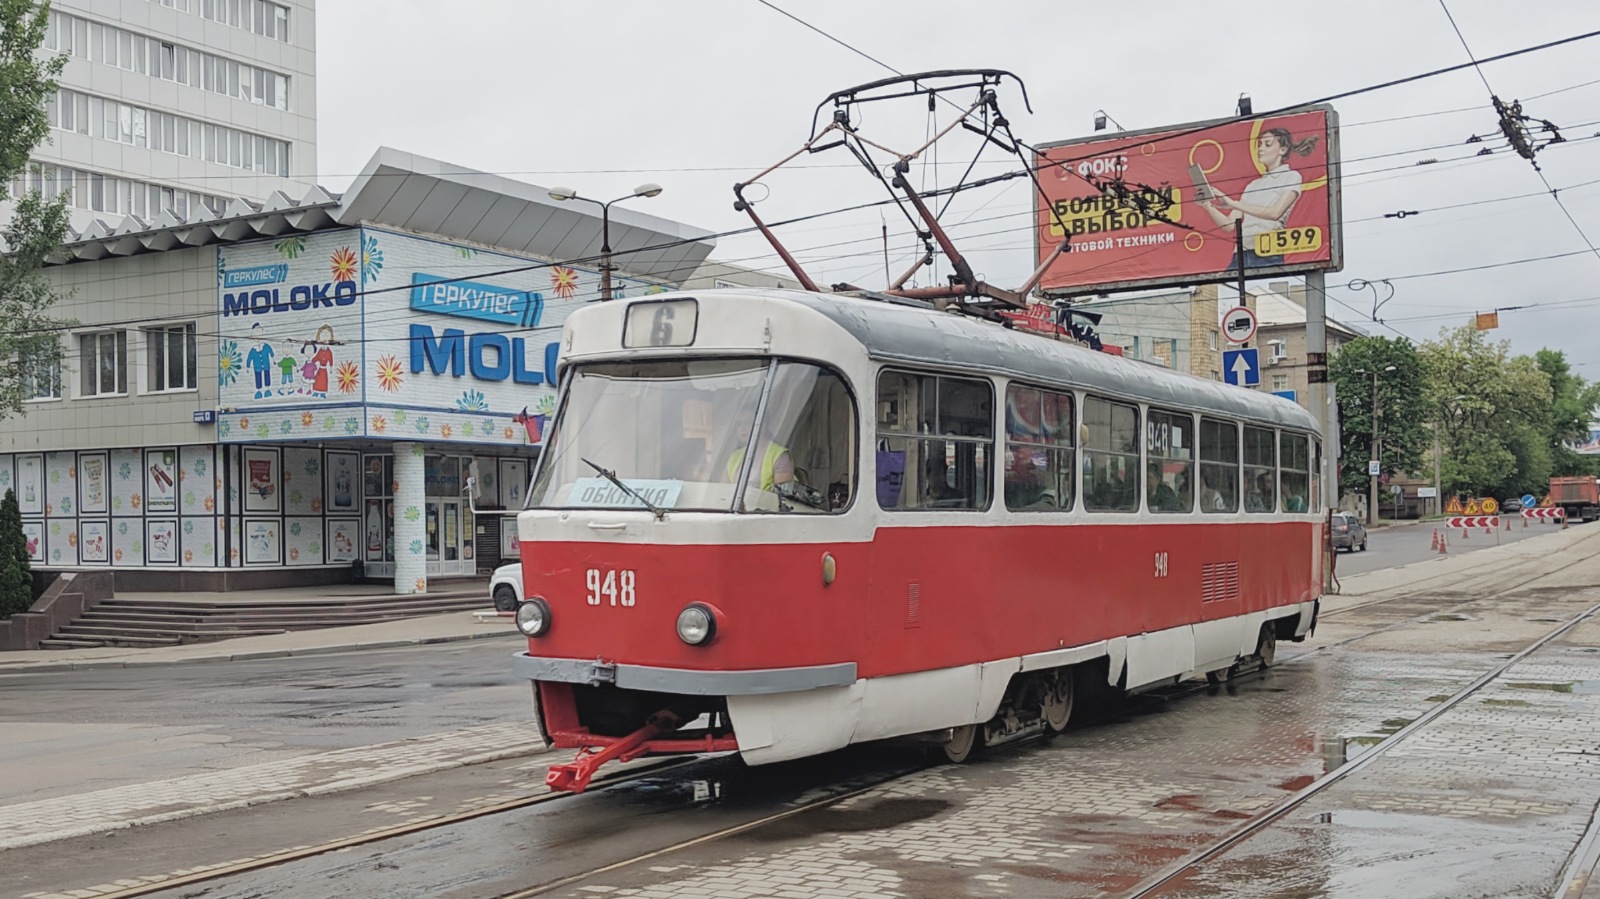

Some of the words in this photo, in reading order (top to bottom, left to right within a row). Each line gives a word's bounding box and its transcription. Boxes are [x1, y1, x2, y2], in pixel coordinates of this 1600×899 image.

[1077, 156, 1128, 176] ФОКС
[1055, 181, 1173, 216] БОЛЬЙ
[1056, 237, 1113, 254] ТОВОЙ
[1116, 232, 1175, 248] ТЕХНИКИ
[1276, 228, 1316, 247] 599
[223, 280, 357, 317] MOLOKO
[650, 303, 675, 346] 6
[1148, 421, 1168, 451] 948
[1154, 552, 1168, 577] 948
[586, 568, 636, 607] 948
